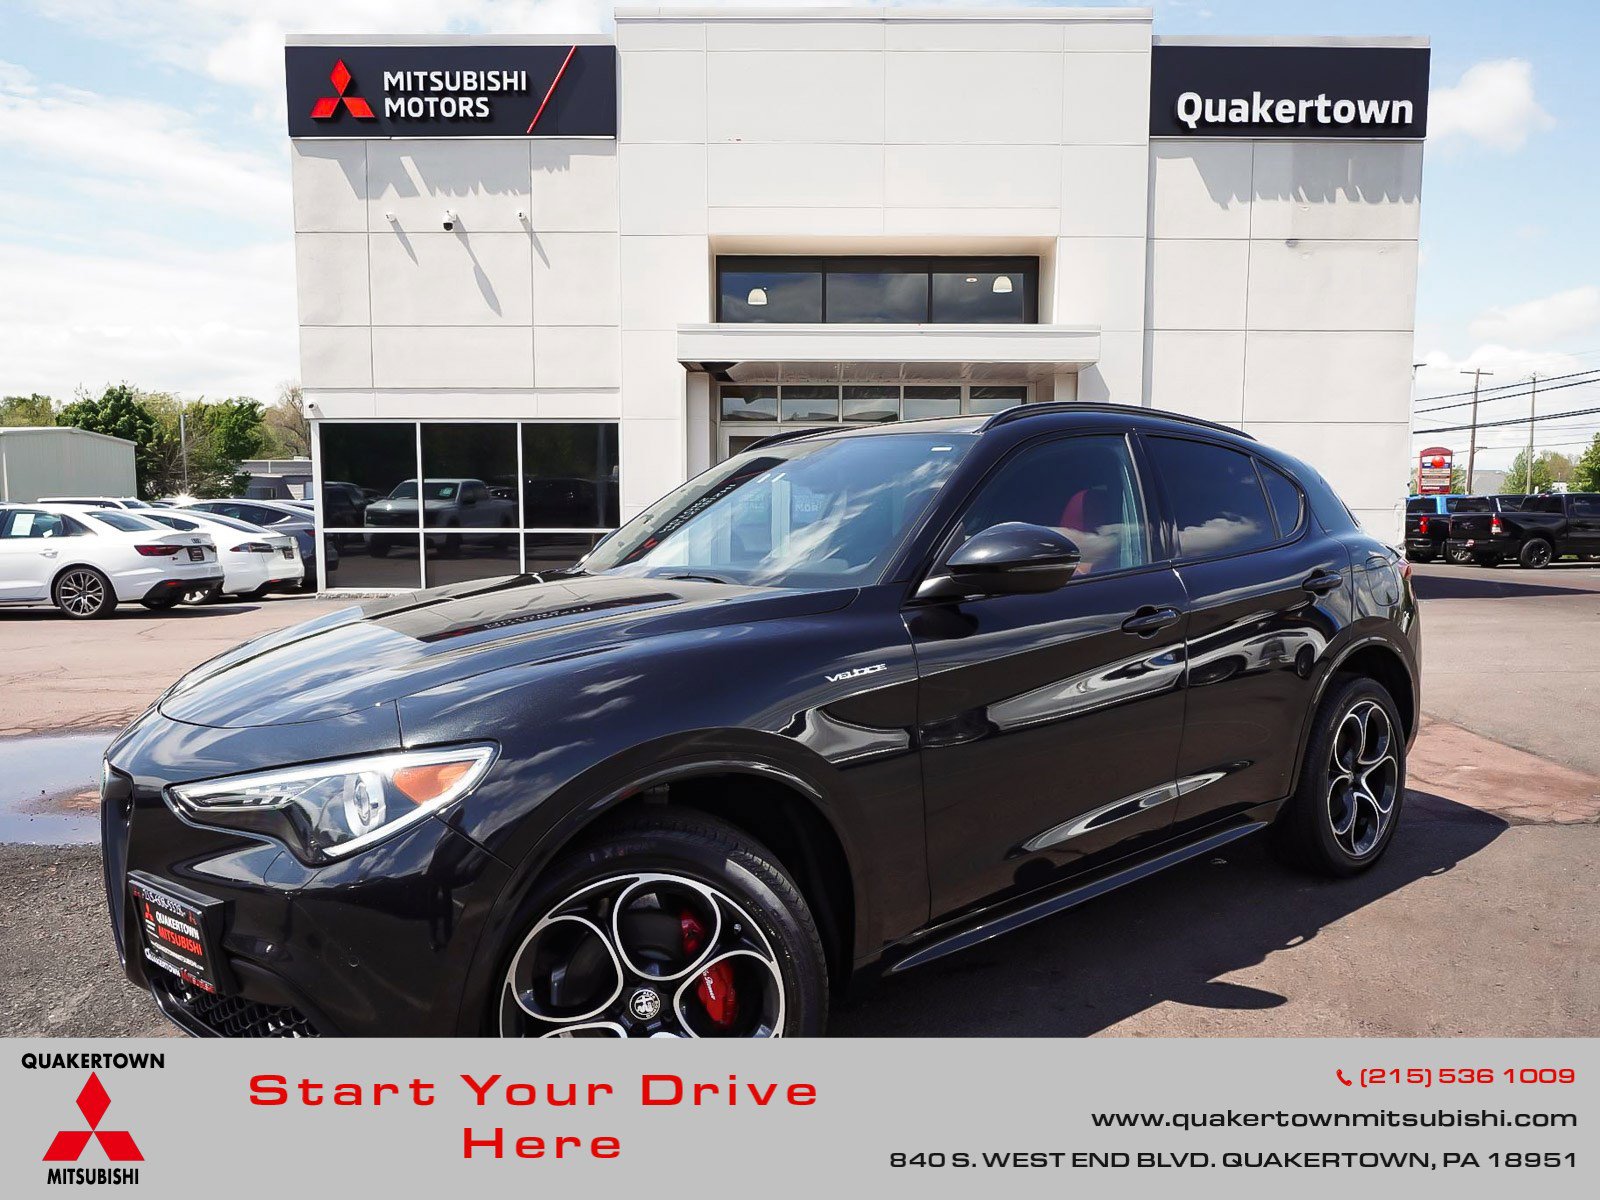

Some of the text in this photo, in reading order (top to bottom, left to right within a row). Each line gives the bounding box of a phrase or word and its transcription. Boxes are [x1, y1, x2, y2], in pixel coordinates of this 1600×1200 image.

[383, 70, 527, 92] MITSUBISHI
[384, 97, 490, 118] MOTORS
[1176, 90, 1414, 129] Quakertown
[155, 911, 200, 940] QUAKERTOWN
[157, 925, 203, 956] MITSUBISHI
